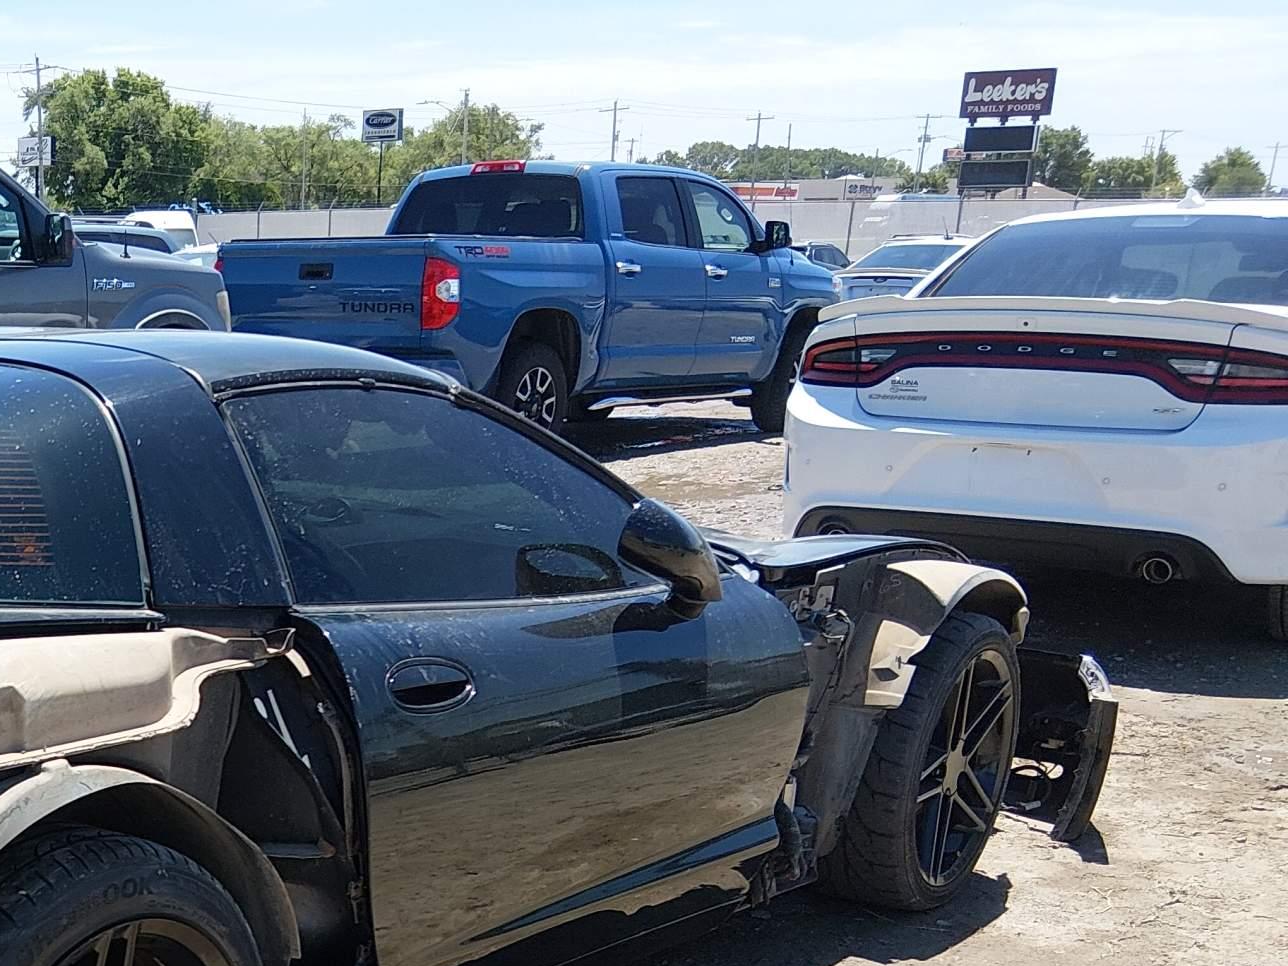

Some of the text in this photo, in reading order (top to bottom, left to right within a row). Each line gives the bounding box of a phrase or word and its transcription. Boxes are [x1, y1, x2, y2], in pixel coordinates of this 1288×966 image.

[964, 76, 1049, 102] Leeker's
[967, 103, 1041, 113] FAMILY FOODS
[454, 245, 484, 257] TRD
[339, 302, 415, 313] TUNDRA
[938, 344, 1117, 357] DODGE
